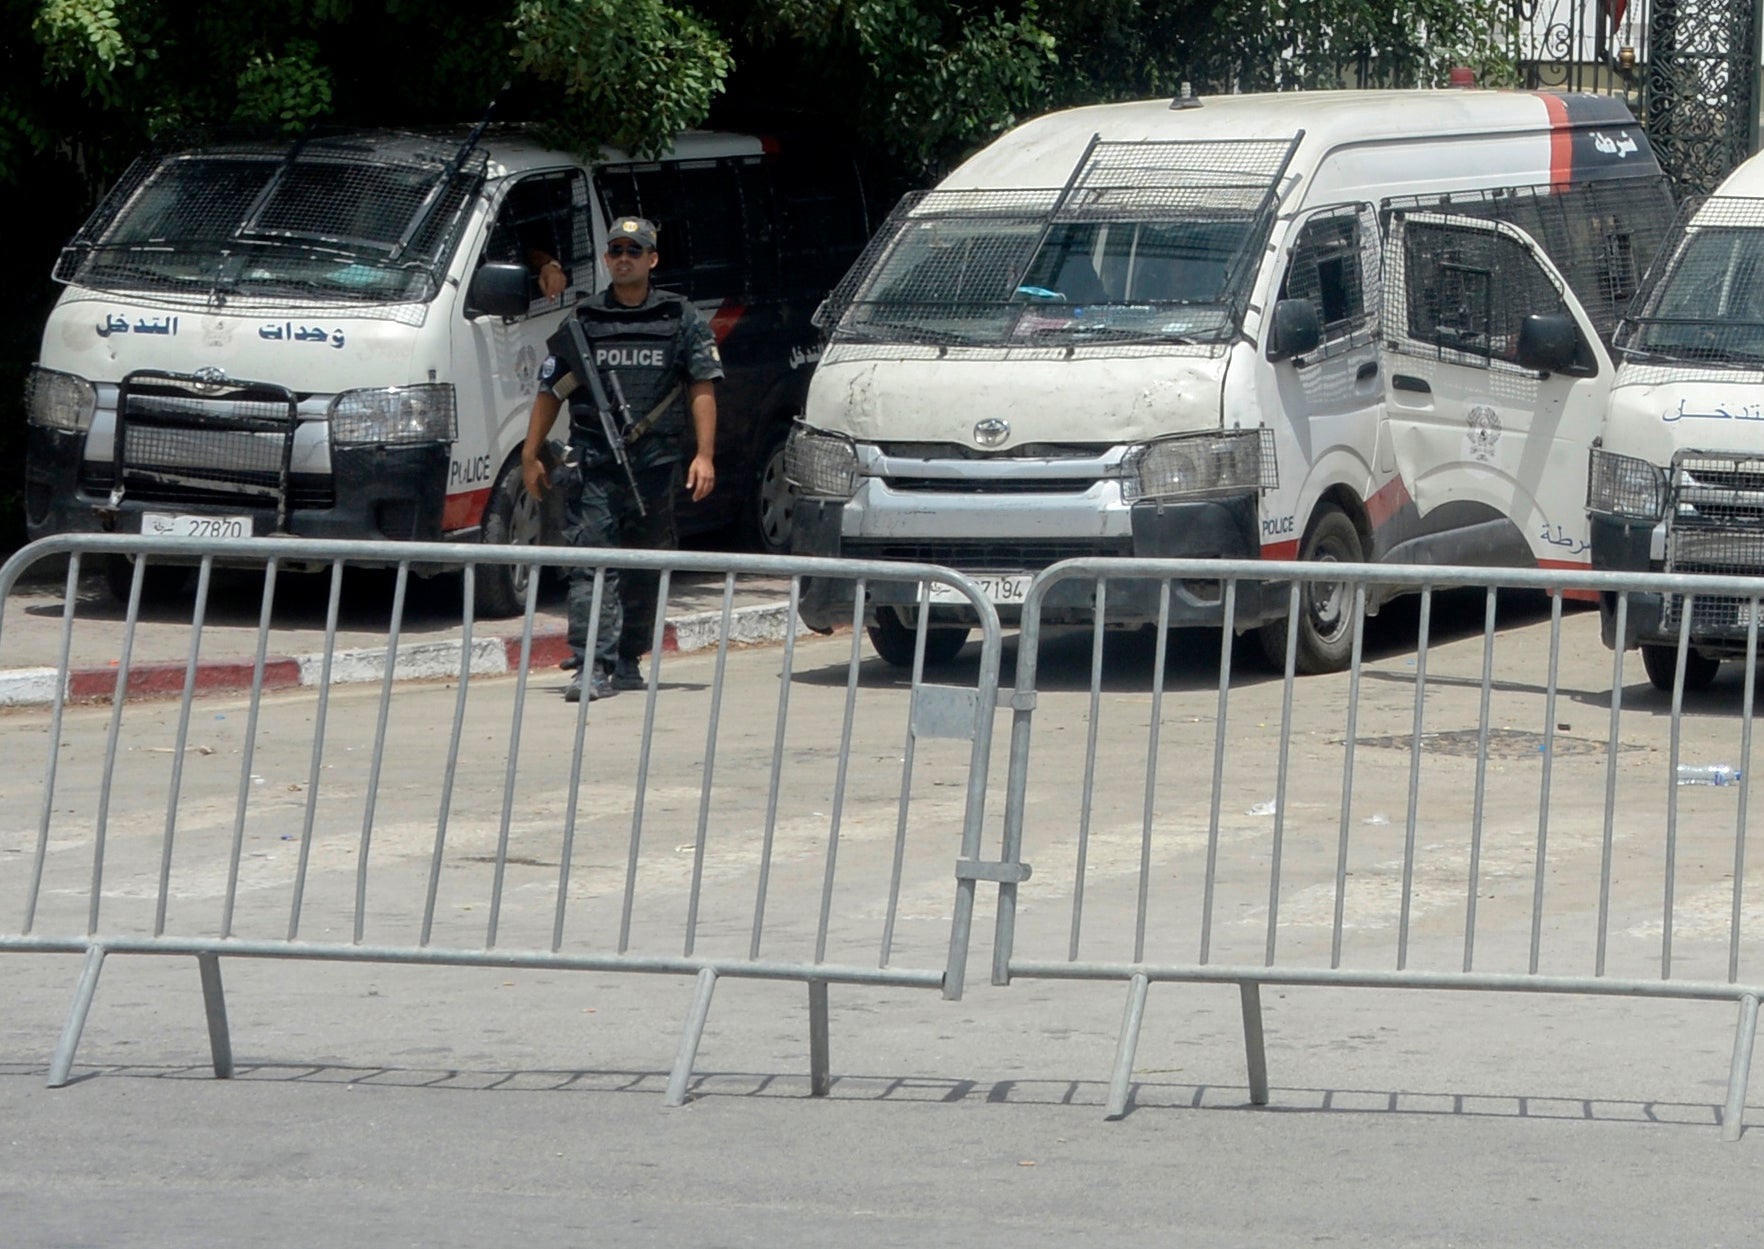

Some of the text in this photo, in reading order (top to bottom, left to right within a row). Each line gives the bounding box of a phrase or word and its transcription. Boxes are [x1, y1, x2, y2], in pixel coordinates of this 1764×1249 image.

[1588, 129, 1638, 159] شرطة
[96, 313, 346, 349] وحدات التدخل
[596, 349, 664, 367] POLICE
[451, 454, 490, 486] POLICE
[188, 520, 242, 538] 27870
[1262, 515, 1294, 537] POLICE
[974, 580, 1024, 600] 7194
